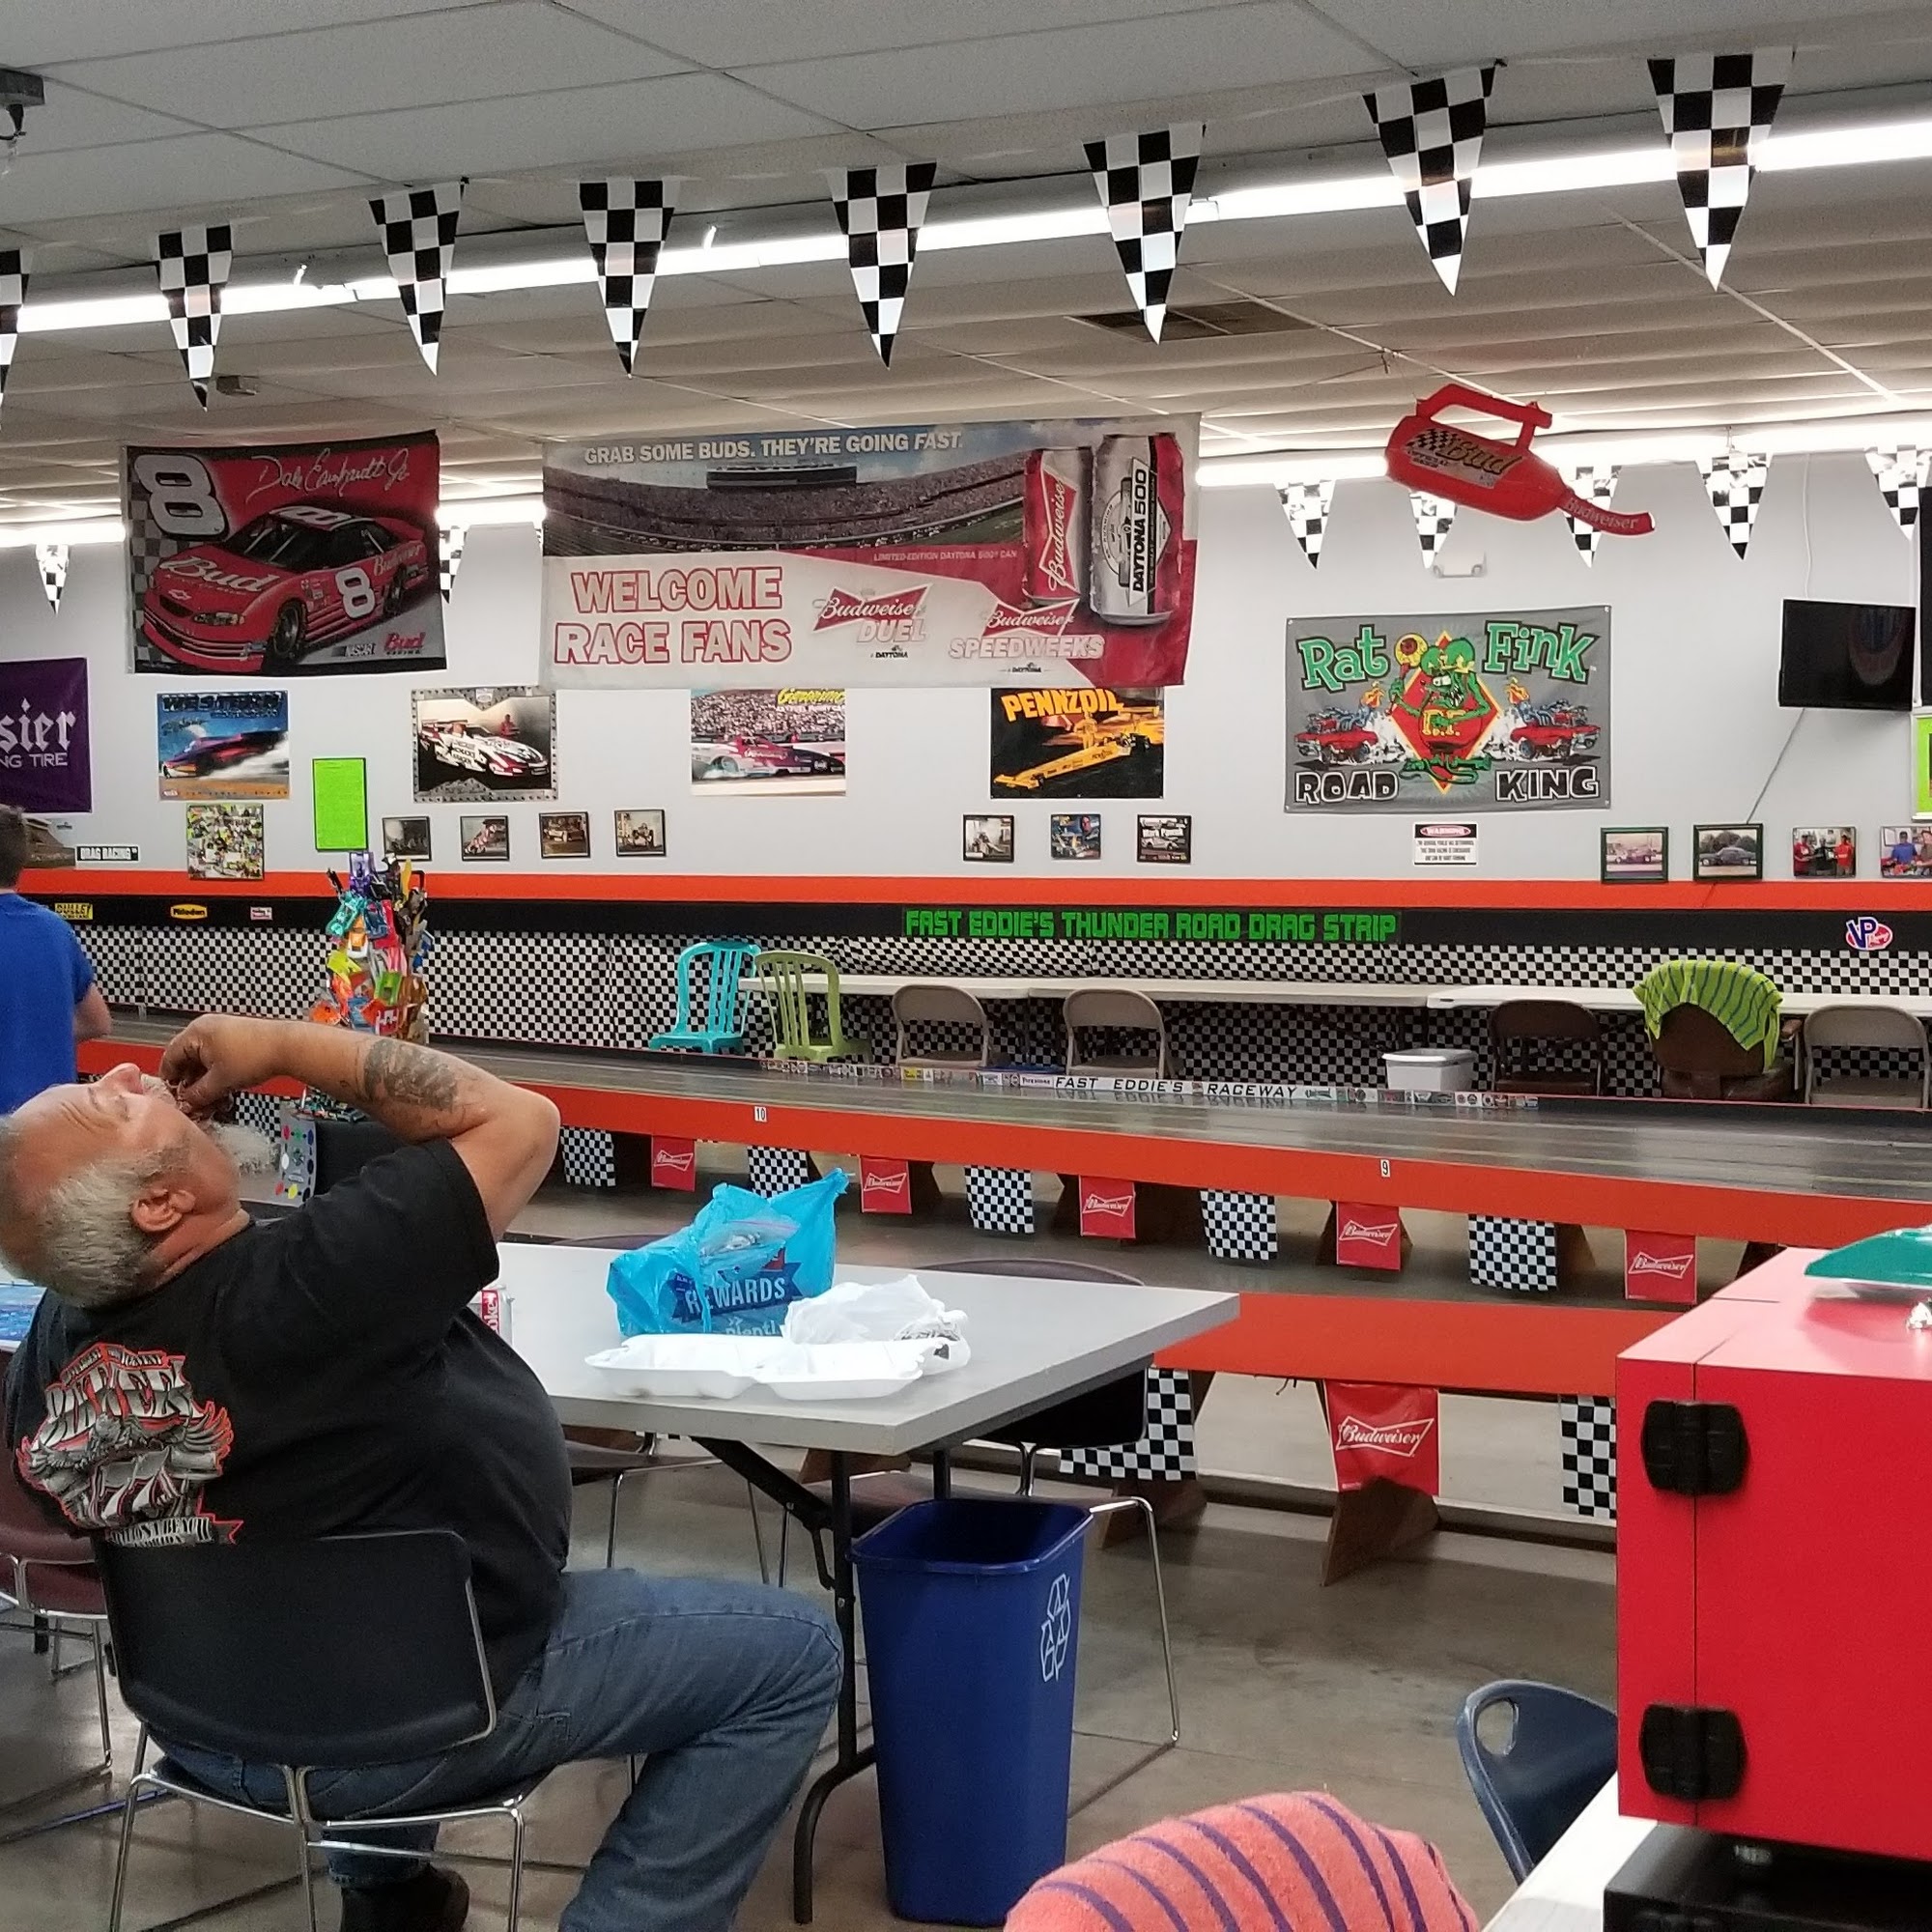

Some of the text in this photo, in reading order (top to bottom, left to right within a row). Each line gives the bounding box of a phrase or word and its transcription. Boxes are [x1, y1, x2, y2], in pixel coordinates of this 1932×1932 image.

[584, 431, 964, 465] GRAB SOME BUDS. THEY'RE GOING FAST.
[135, 454, 229, 537] 8
[1132, 469, 1147, 592] DAYTONA 500
[159, 556, 280, 591] Bud
[570, 566, 782, 613] WELCOME
[335, 568, 376, 618] 8
[554, 618, 792, 665] RACE FANS
[856, 618, 926, 642] DUEL
[949, 635, 1105, 660] SPEEDWEEKS
[1295, 621, 1601, 693] Rat Fink
[1001, 689, 1124, 723] PENNZOIL
[29, 753, 68, 767] TIRE
[1295, 766, 1600, 804] ROAD KING
[905, 910, 1397, 942] FAST EDDIE'S THUNDER ROAD DRAG STRIP
[1847, 918, 1878, 949] VP
[1056, 1076, 1099, 1091] FAST
[1113, 1079, 1184, 1094] EDDIE'S
[1207, 1083, 1297, 1098] RACEWAY
[754, 1107, 767, 1122] 10
[1381, 1160, 1389, 1176] 9
[1339, 1421, 1420, 1447] Budweiser
